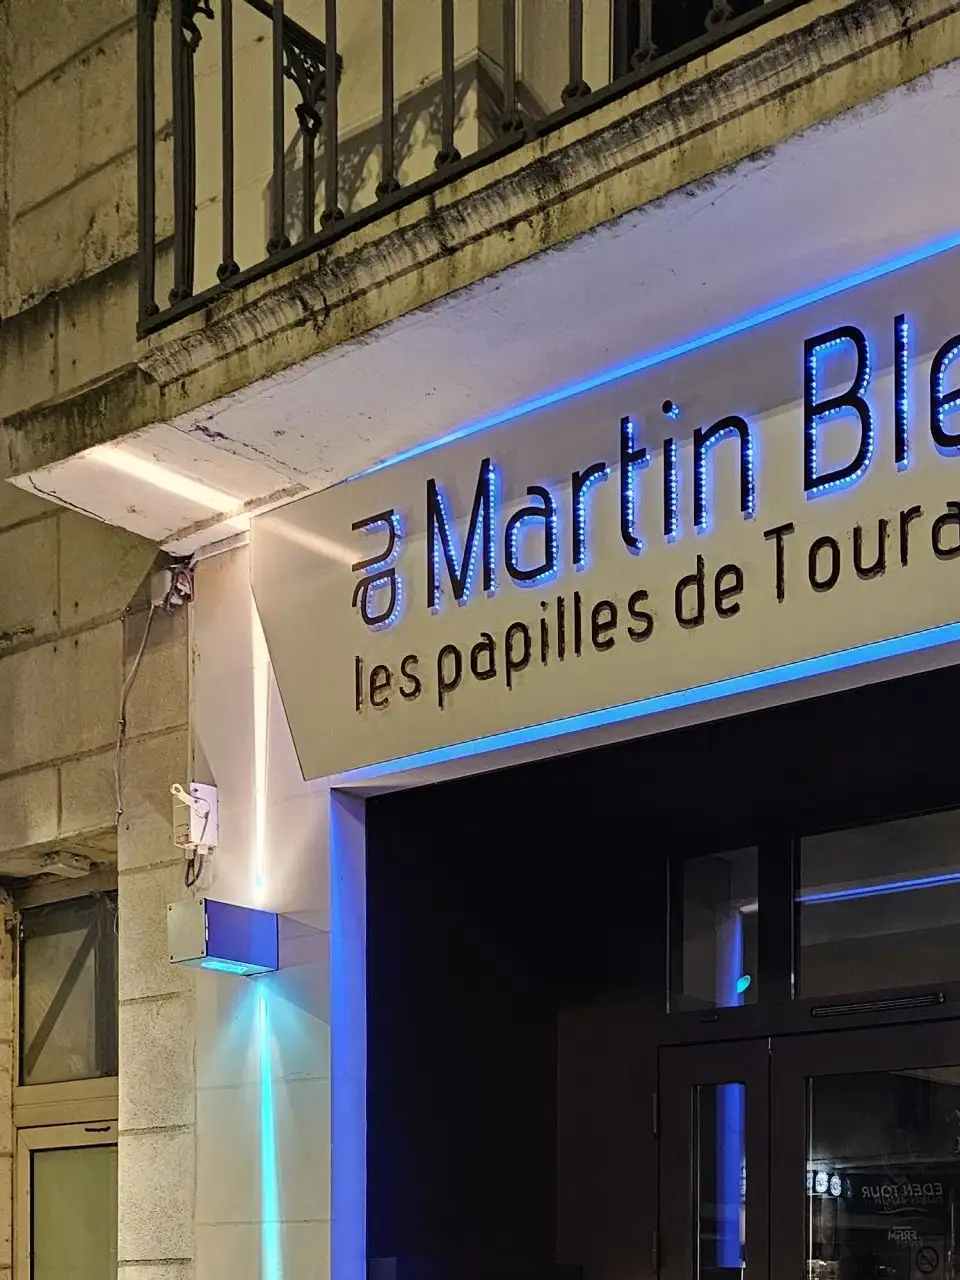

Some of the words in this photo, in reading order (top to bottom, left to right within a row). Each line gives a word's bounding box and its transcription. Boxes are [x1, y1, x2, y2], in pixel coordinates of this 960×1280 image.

[426, 400, 757, 613] Martin
[353, 654, 422, 713] les
[437, 588, 656, 709] papilles
[674, 555, 745, 629] de
